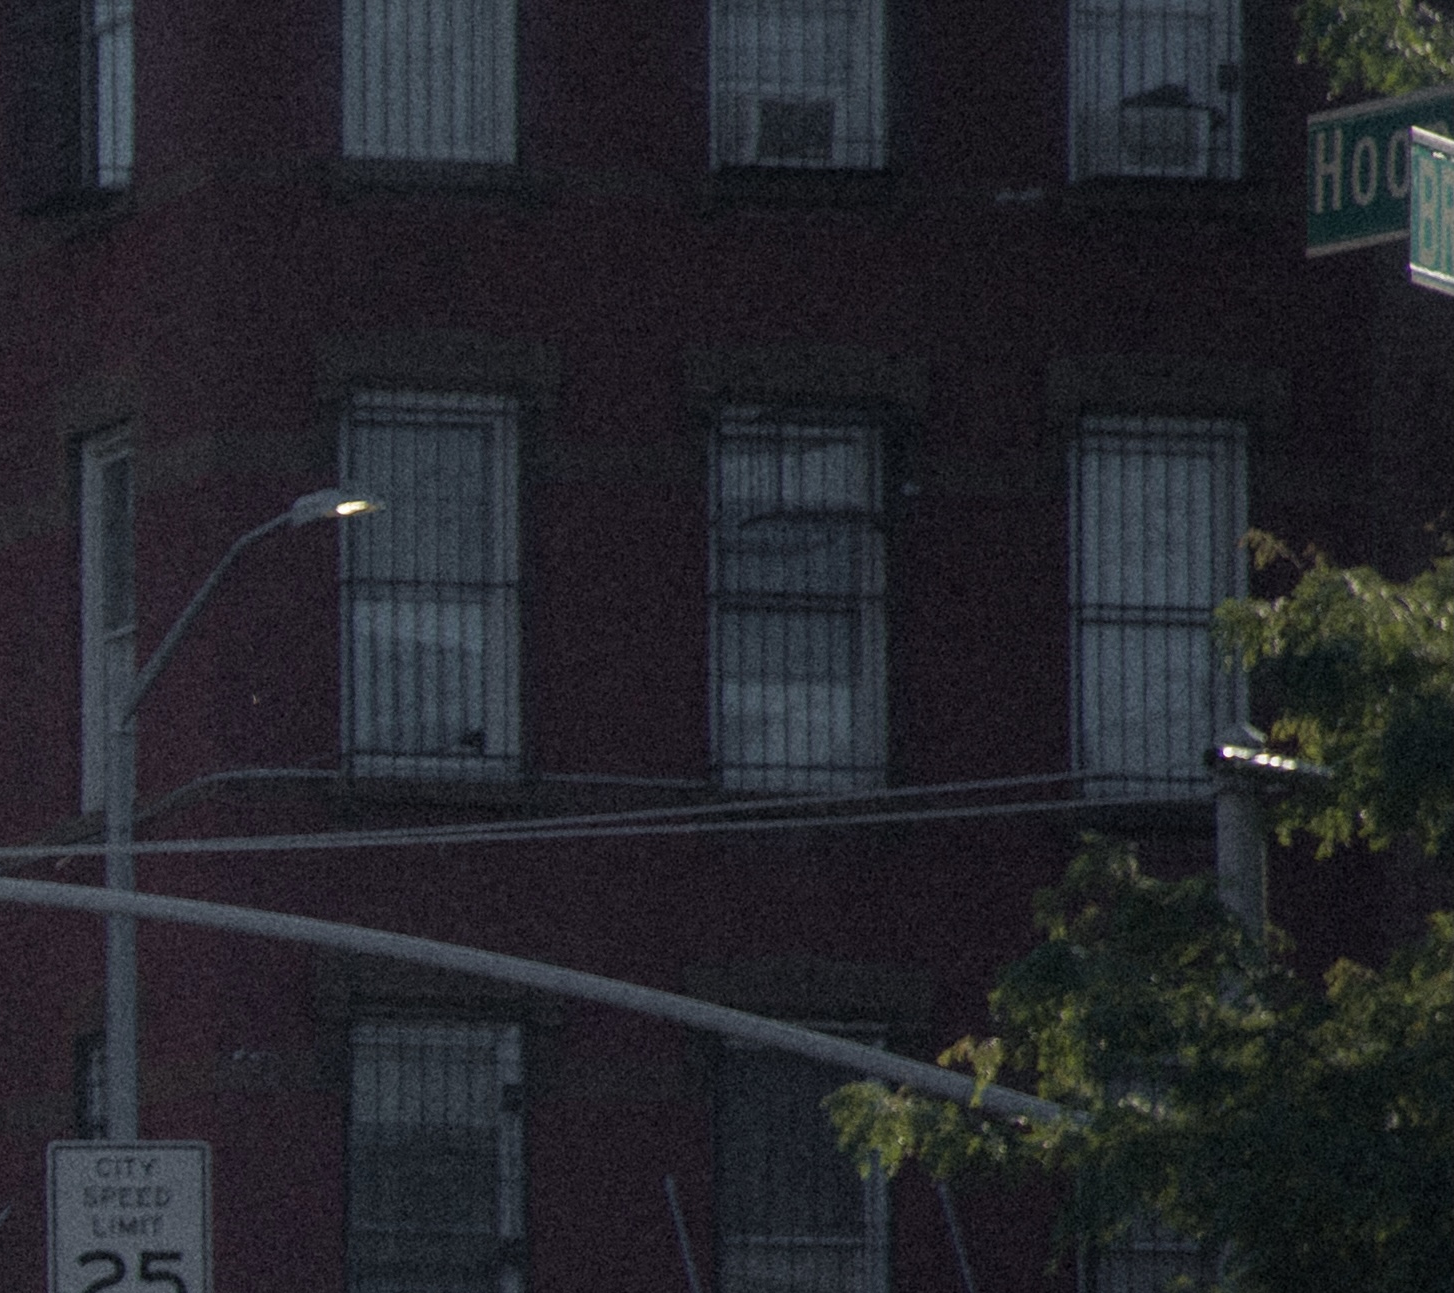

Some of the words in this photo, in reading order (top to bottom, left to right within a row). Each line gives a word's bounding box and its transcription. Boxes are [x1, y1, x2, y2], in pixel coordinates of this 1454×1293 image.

[95, 1157, 157, 1178] CITY
[82, 1185, 172, 1207] SPEED
[92, 1215, 162, 1238] LIMIT
